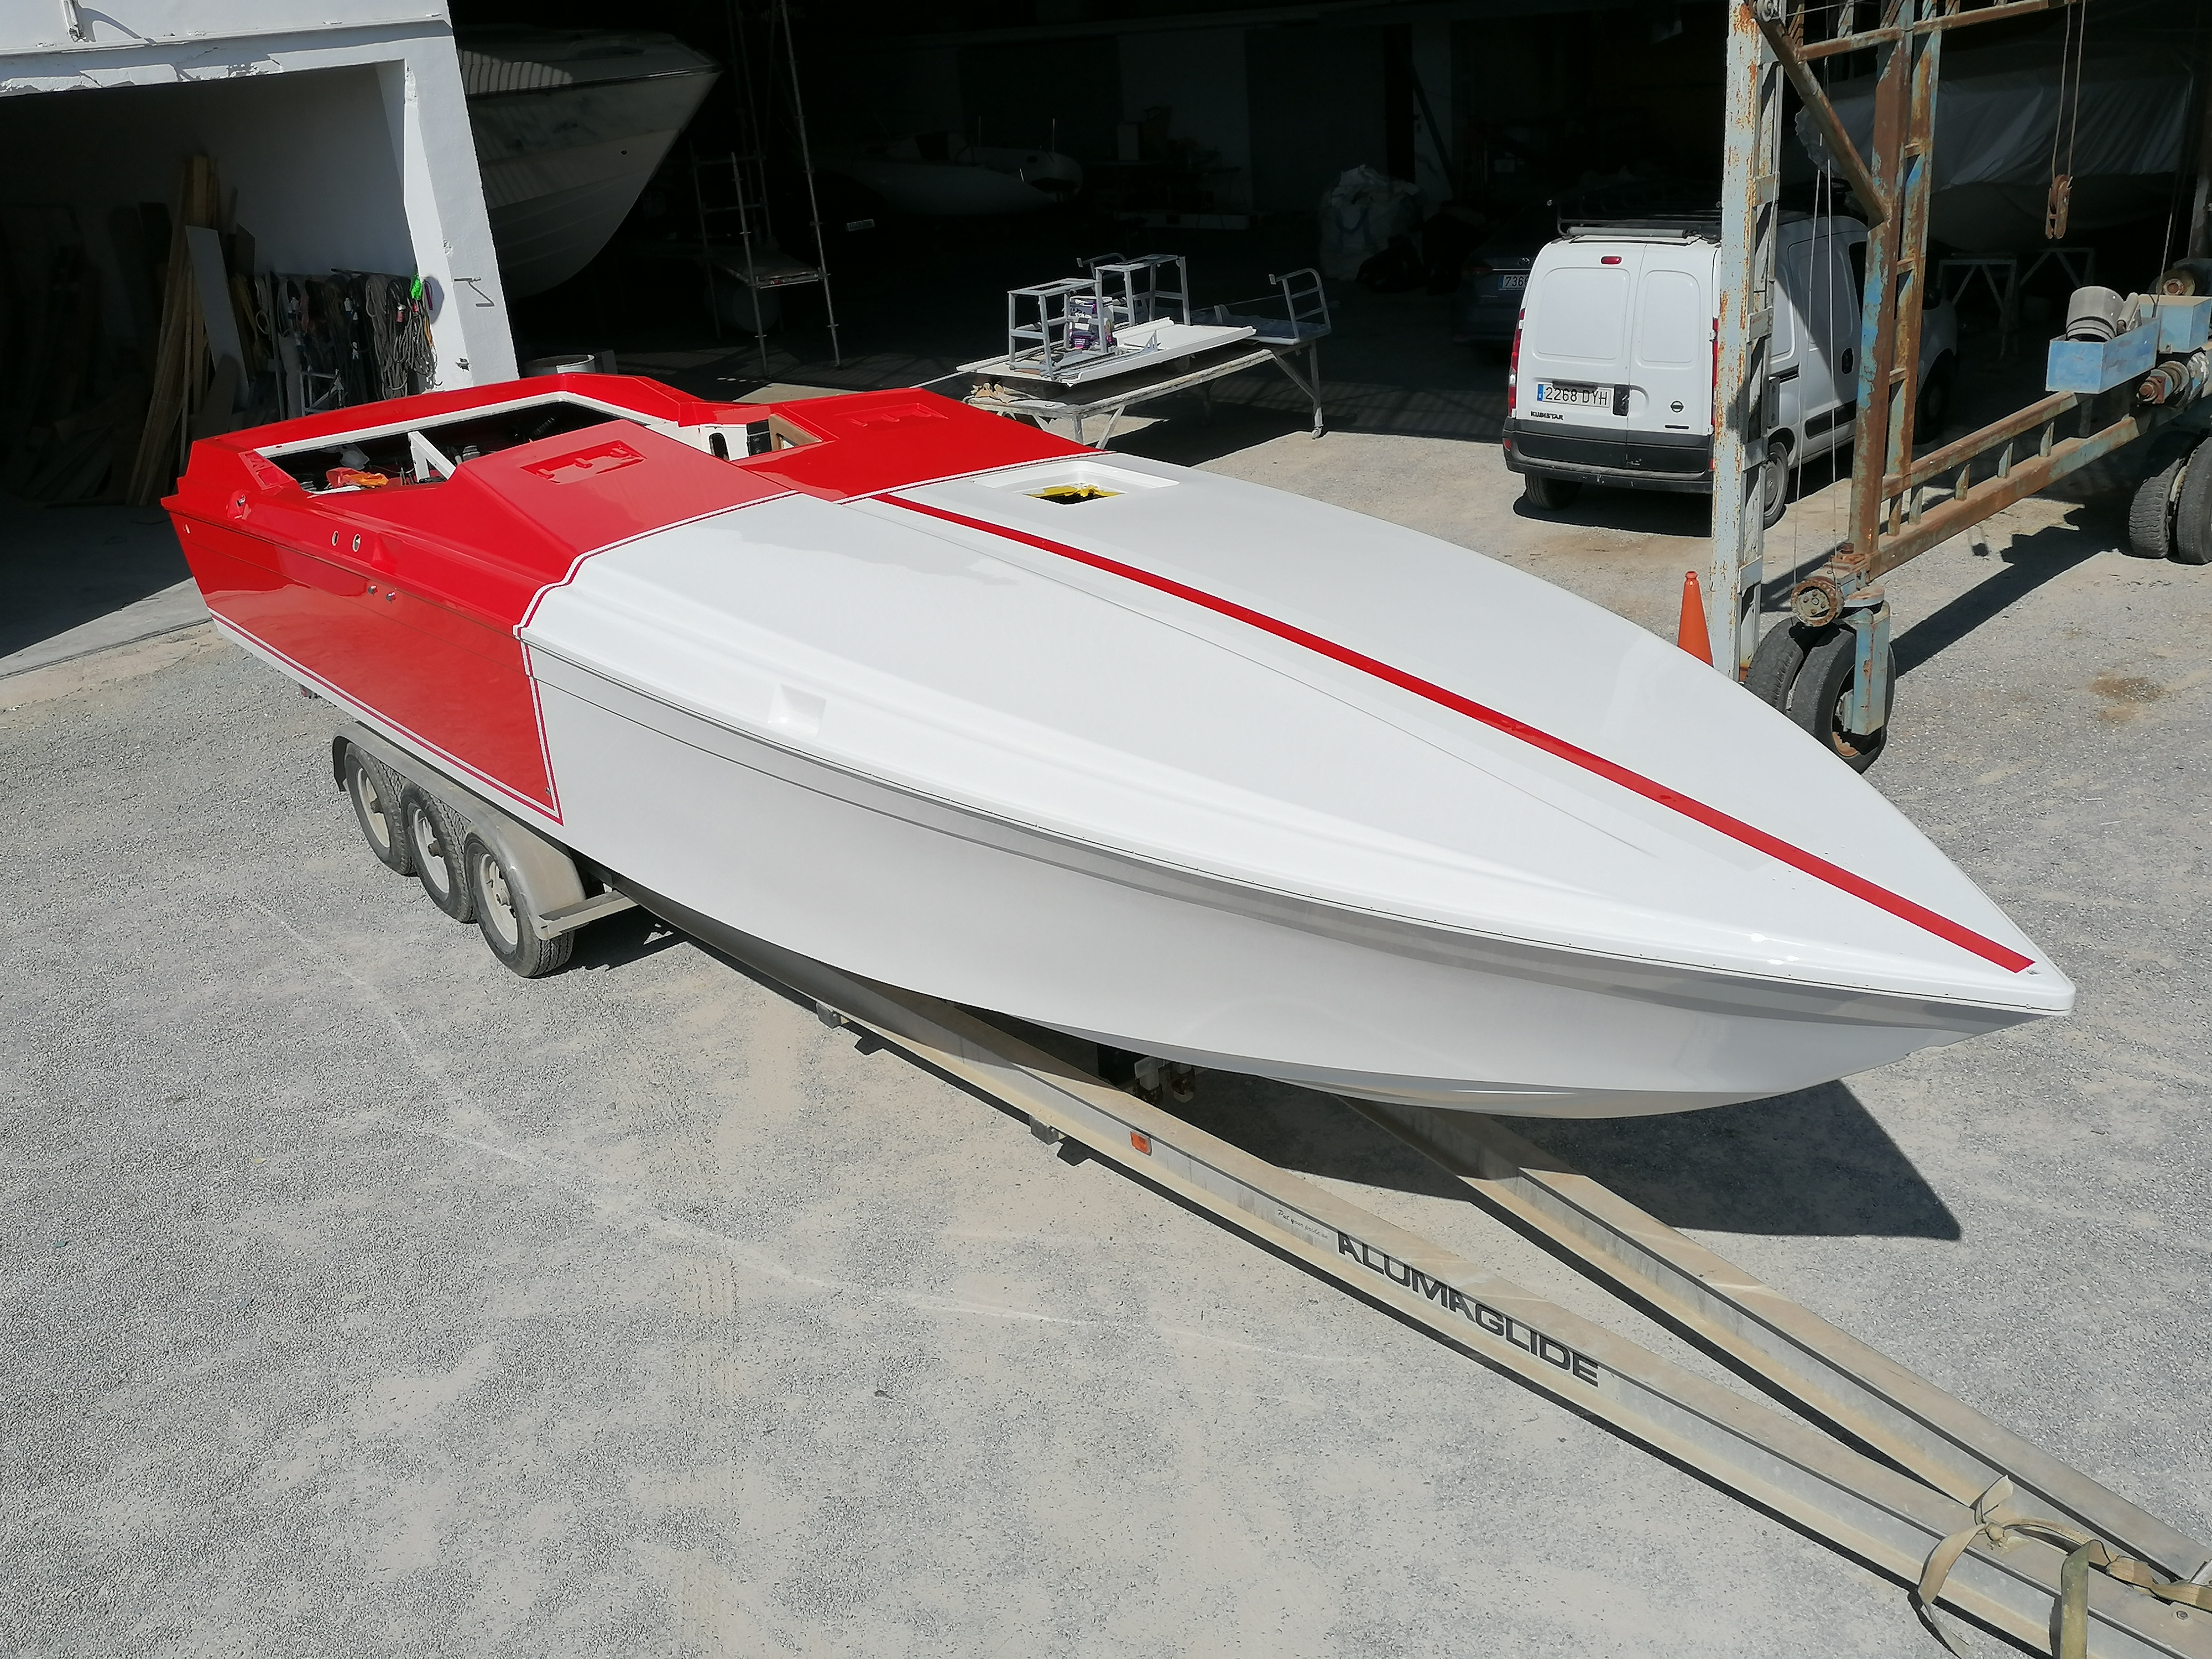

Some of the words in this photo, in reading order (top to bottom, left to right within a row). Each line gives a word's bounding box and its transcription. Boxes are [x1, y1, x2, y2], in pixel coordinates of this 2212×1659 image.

[1546, 387, 1577, 403] 2268
[1582, 389, 1608, 405] DYH
[1277, 1209, 1290, 1220] Put
[1291, 1218, 1303, 1228] your
[1338, 1230, 1598, 1387] ALUMAGLIDE
